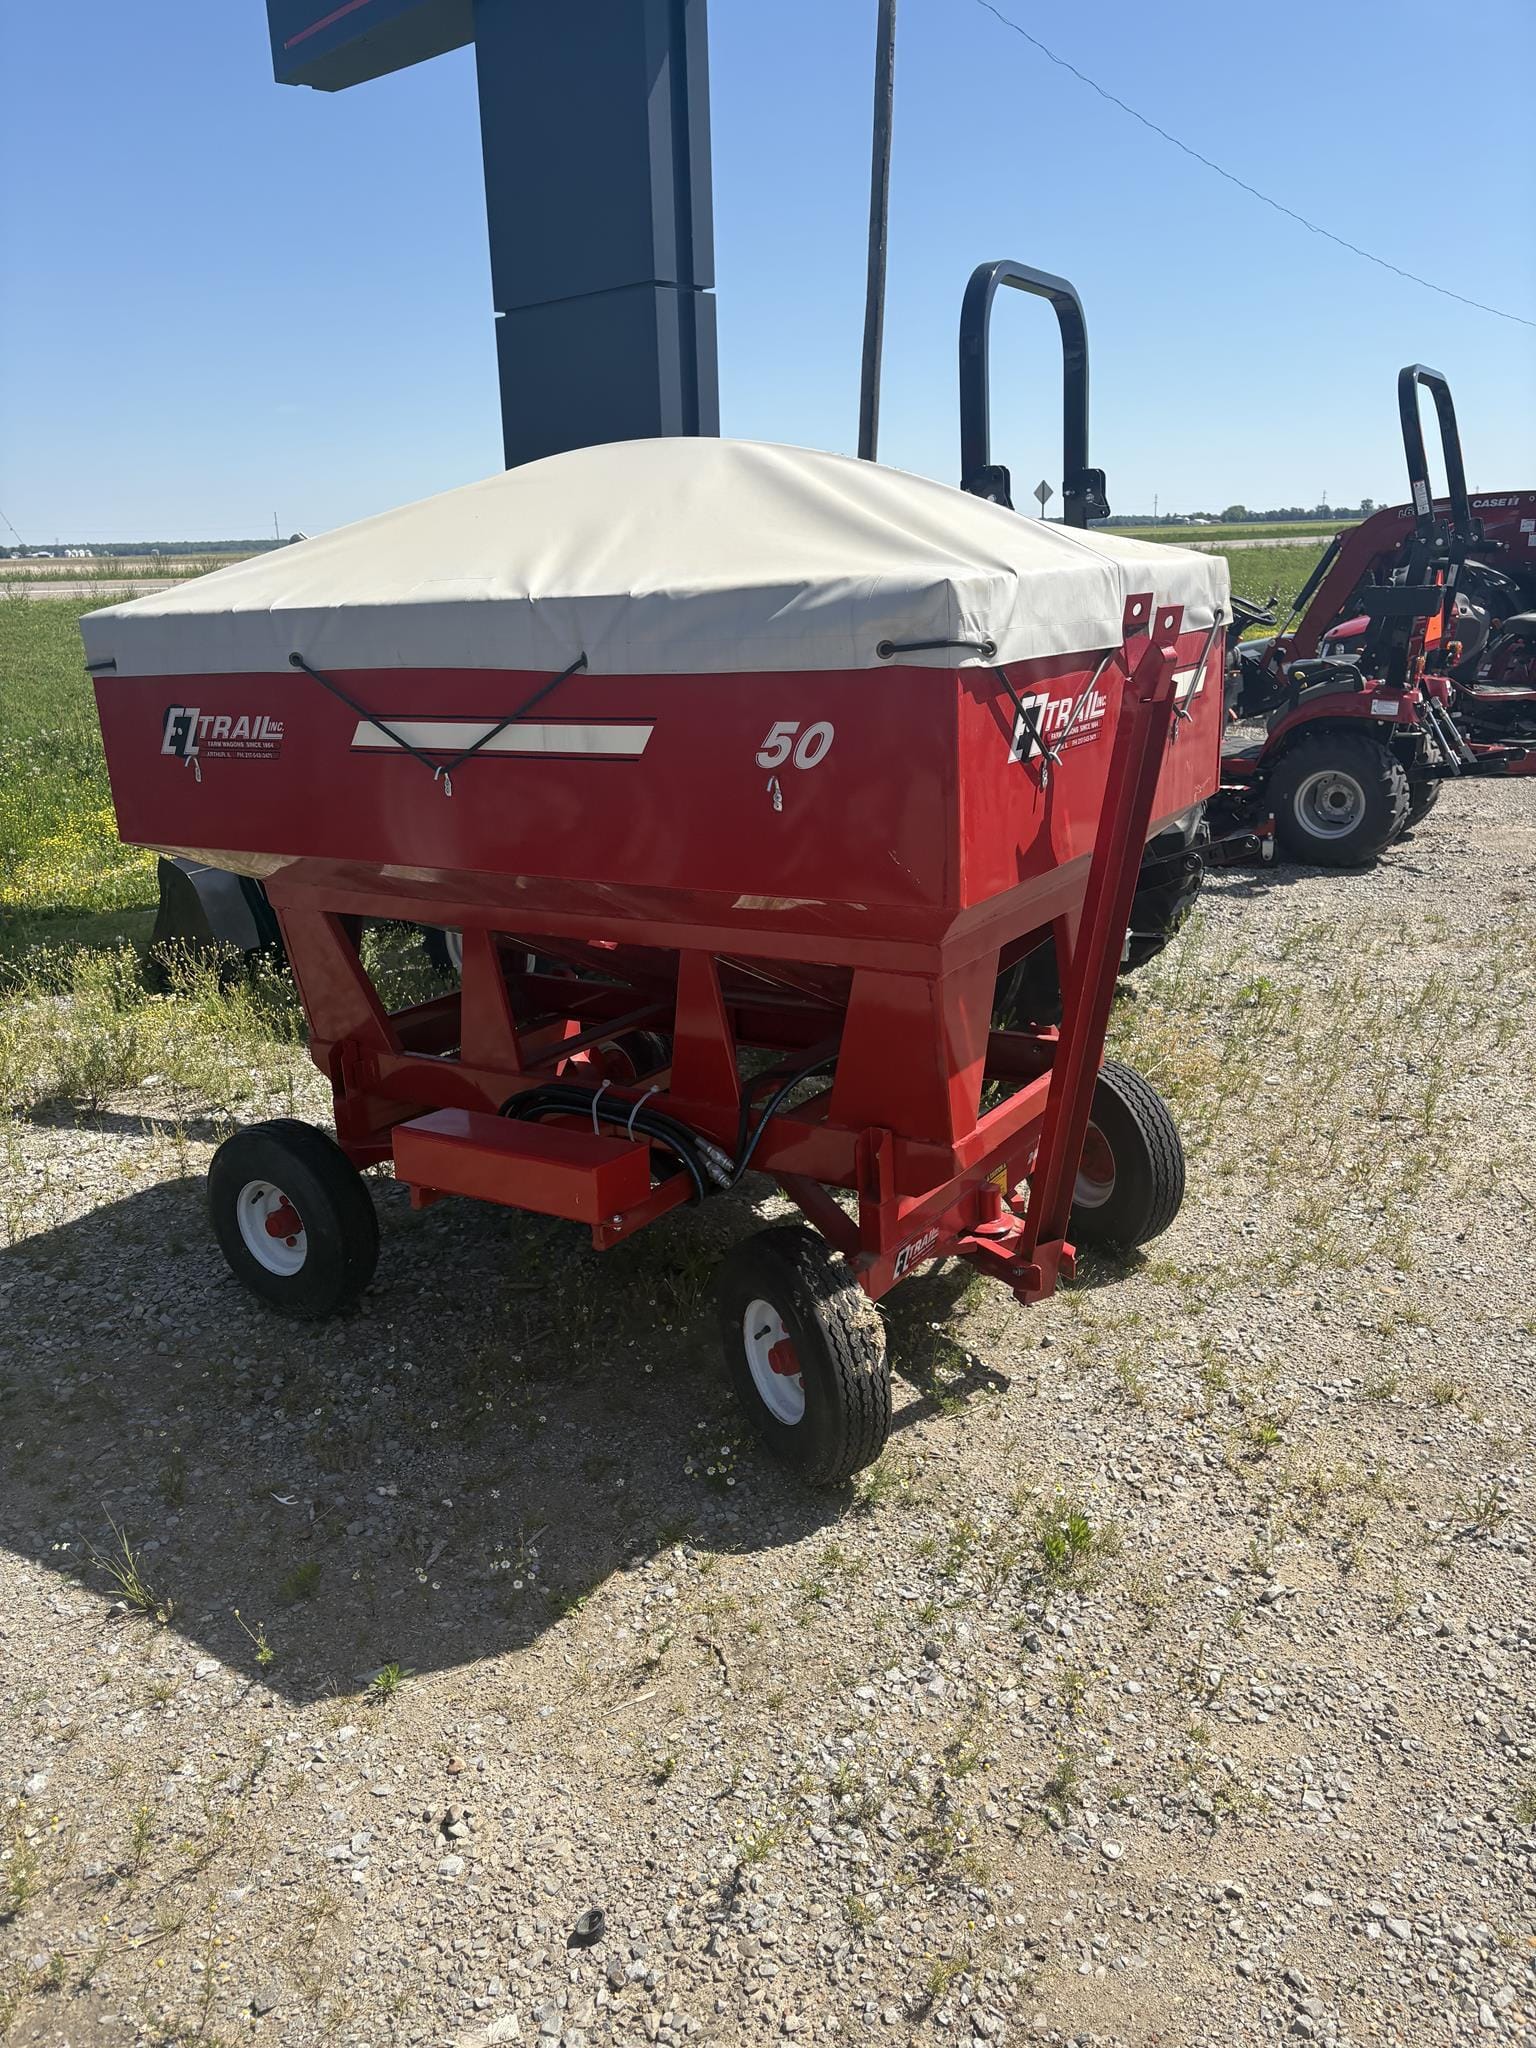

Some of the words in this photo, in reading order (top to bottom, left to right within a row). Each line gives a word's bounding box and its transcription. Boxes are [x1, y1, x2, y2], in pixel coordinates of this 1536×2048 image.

[1472, 498, 1506, 508] CASE
[1507, 496, 1520, 506] IH
[199, 716, 283, 740] TRAIL
[267, 721, 285, 732] INC.
[246, 741, 262, 749] SINCE
[755, 721, 835, 770] 50
[908, 1229, 939, 1259] TRAIL
